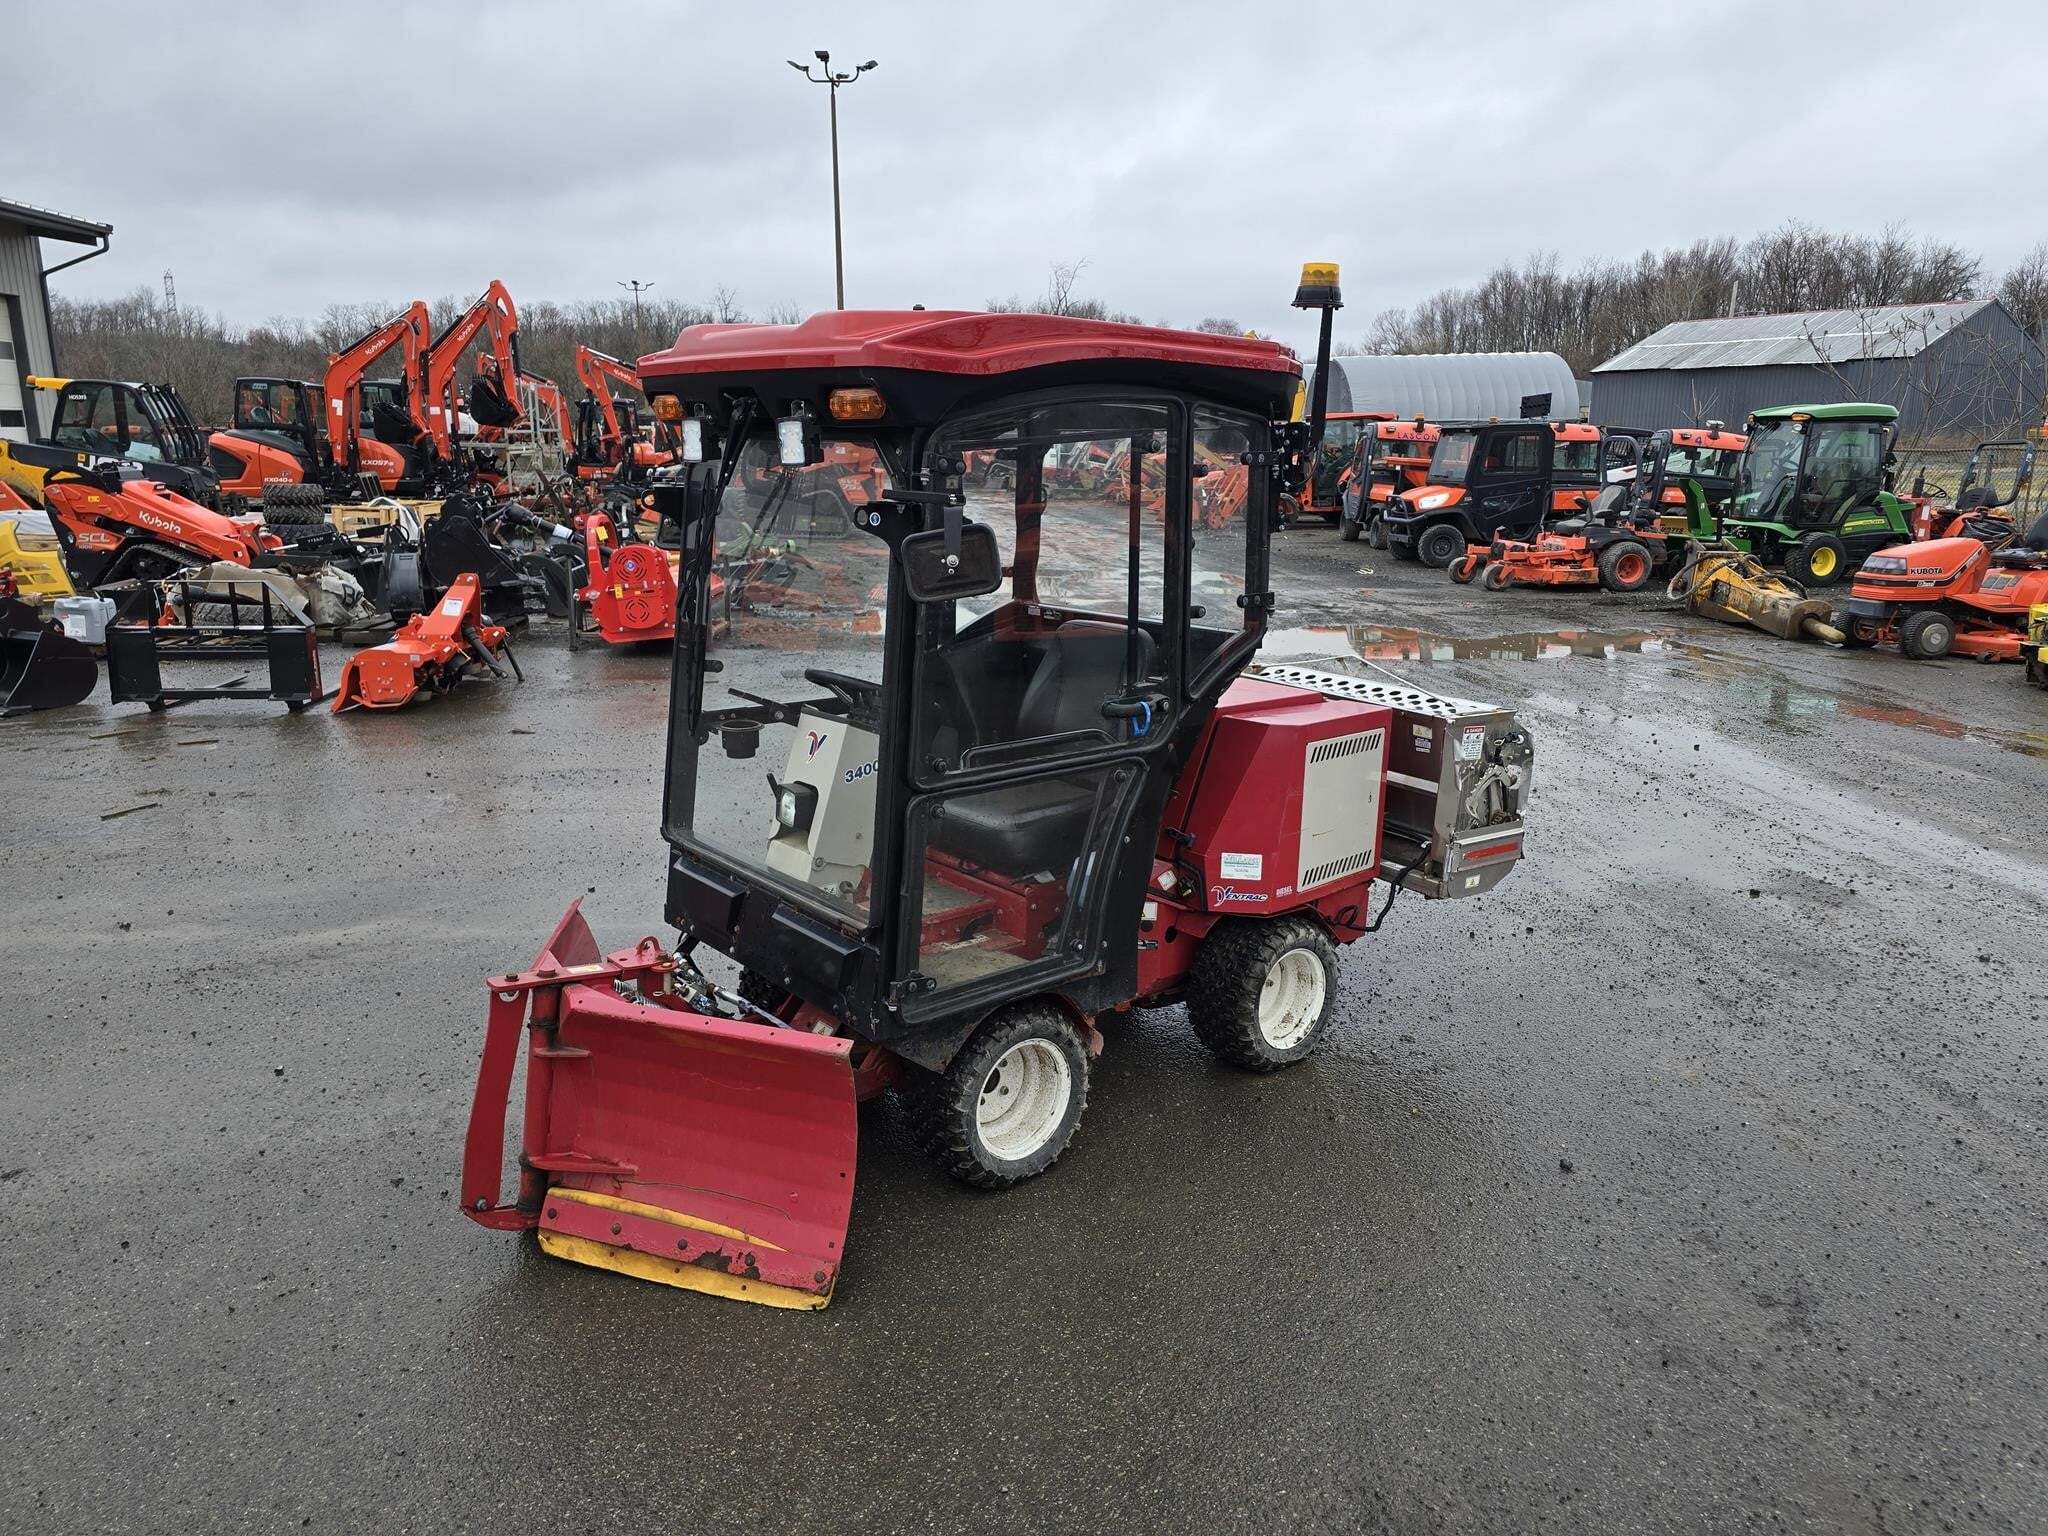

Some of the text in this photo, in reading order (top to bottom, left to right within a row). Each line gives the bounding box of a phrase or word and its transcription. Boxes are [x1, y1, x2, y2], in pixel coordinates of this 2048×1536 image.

[139, 510, 181, 534] Kubota
[1910, 567, 1943, 575] KUBOTA
[1210, 885, 1269, 908] VENTRAC
